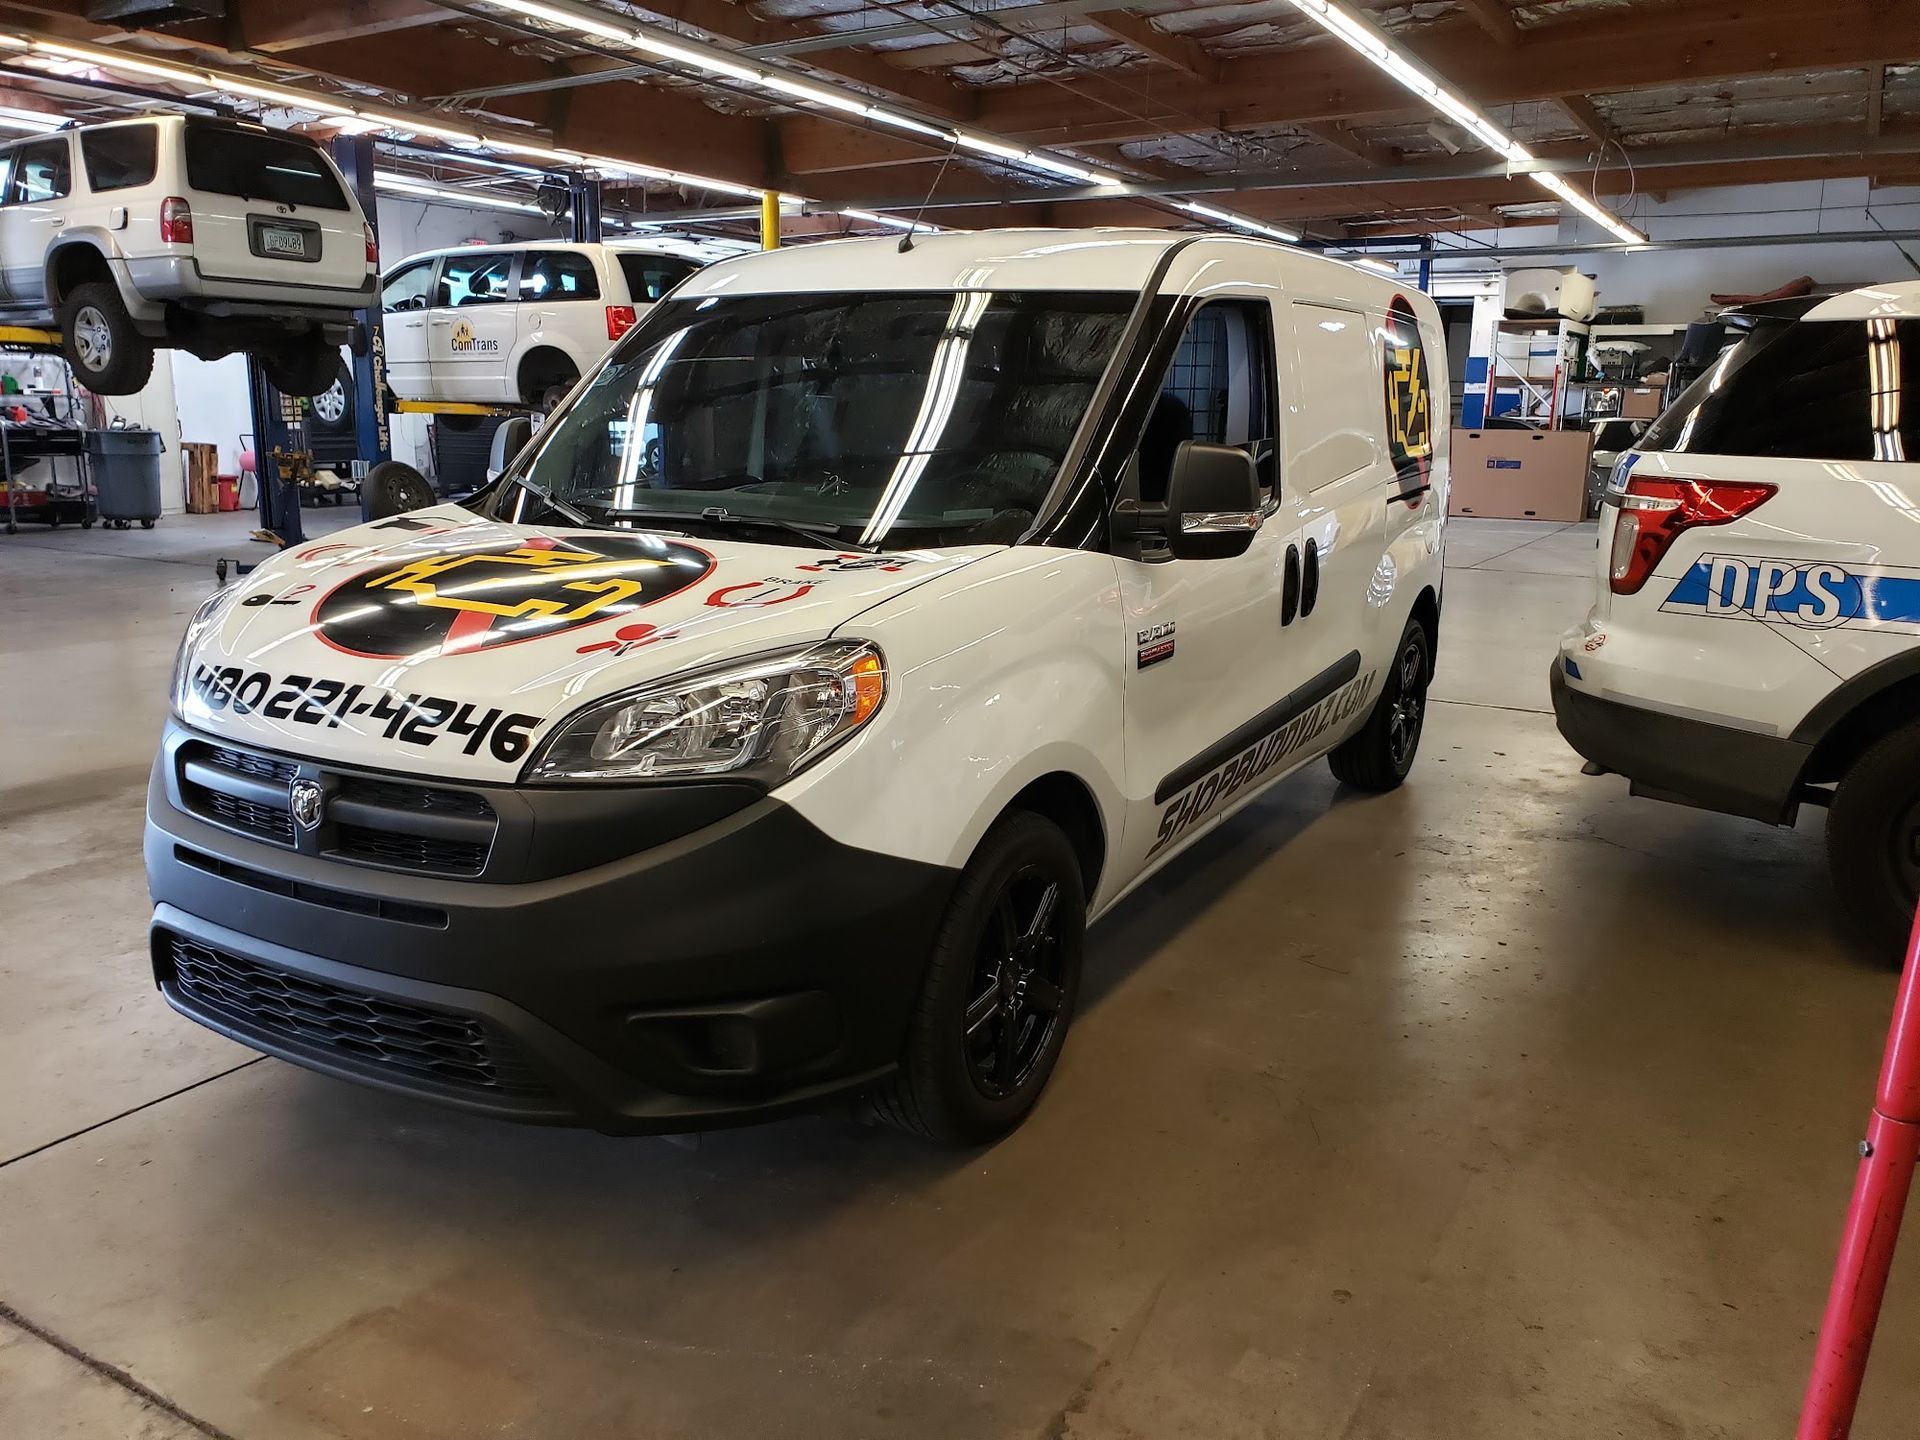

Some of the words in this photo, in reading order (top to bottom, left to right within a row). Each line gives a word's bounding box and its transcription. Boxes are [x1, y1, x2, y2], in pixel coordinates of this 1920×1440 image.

[451, 337, 498, 351] ComTrans
[373, 356, 388, 426] Challenger
[378, 425, 389, 453] Lifts
[762, 576, 831, 585] BRAKE
[1706, 557, 1846, 624] DPS
[1136, 621, 1176, 646] RAM
